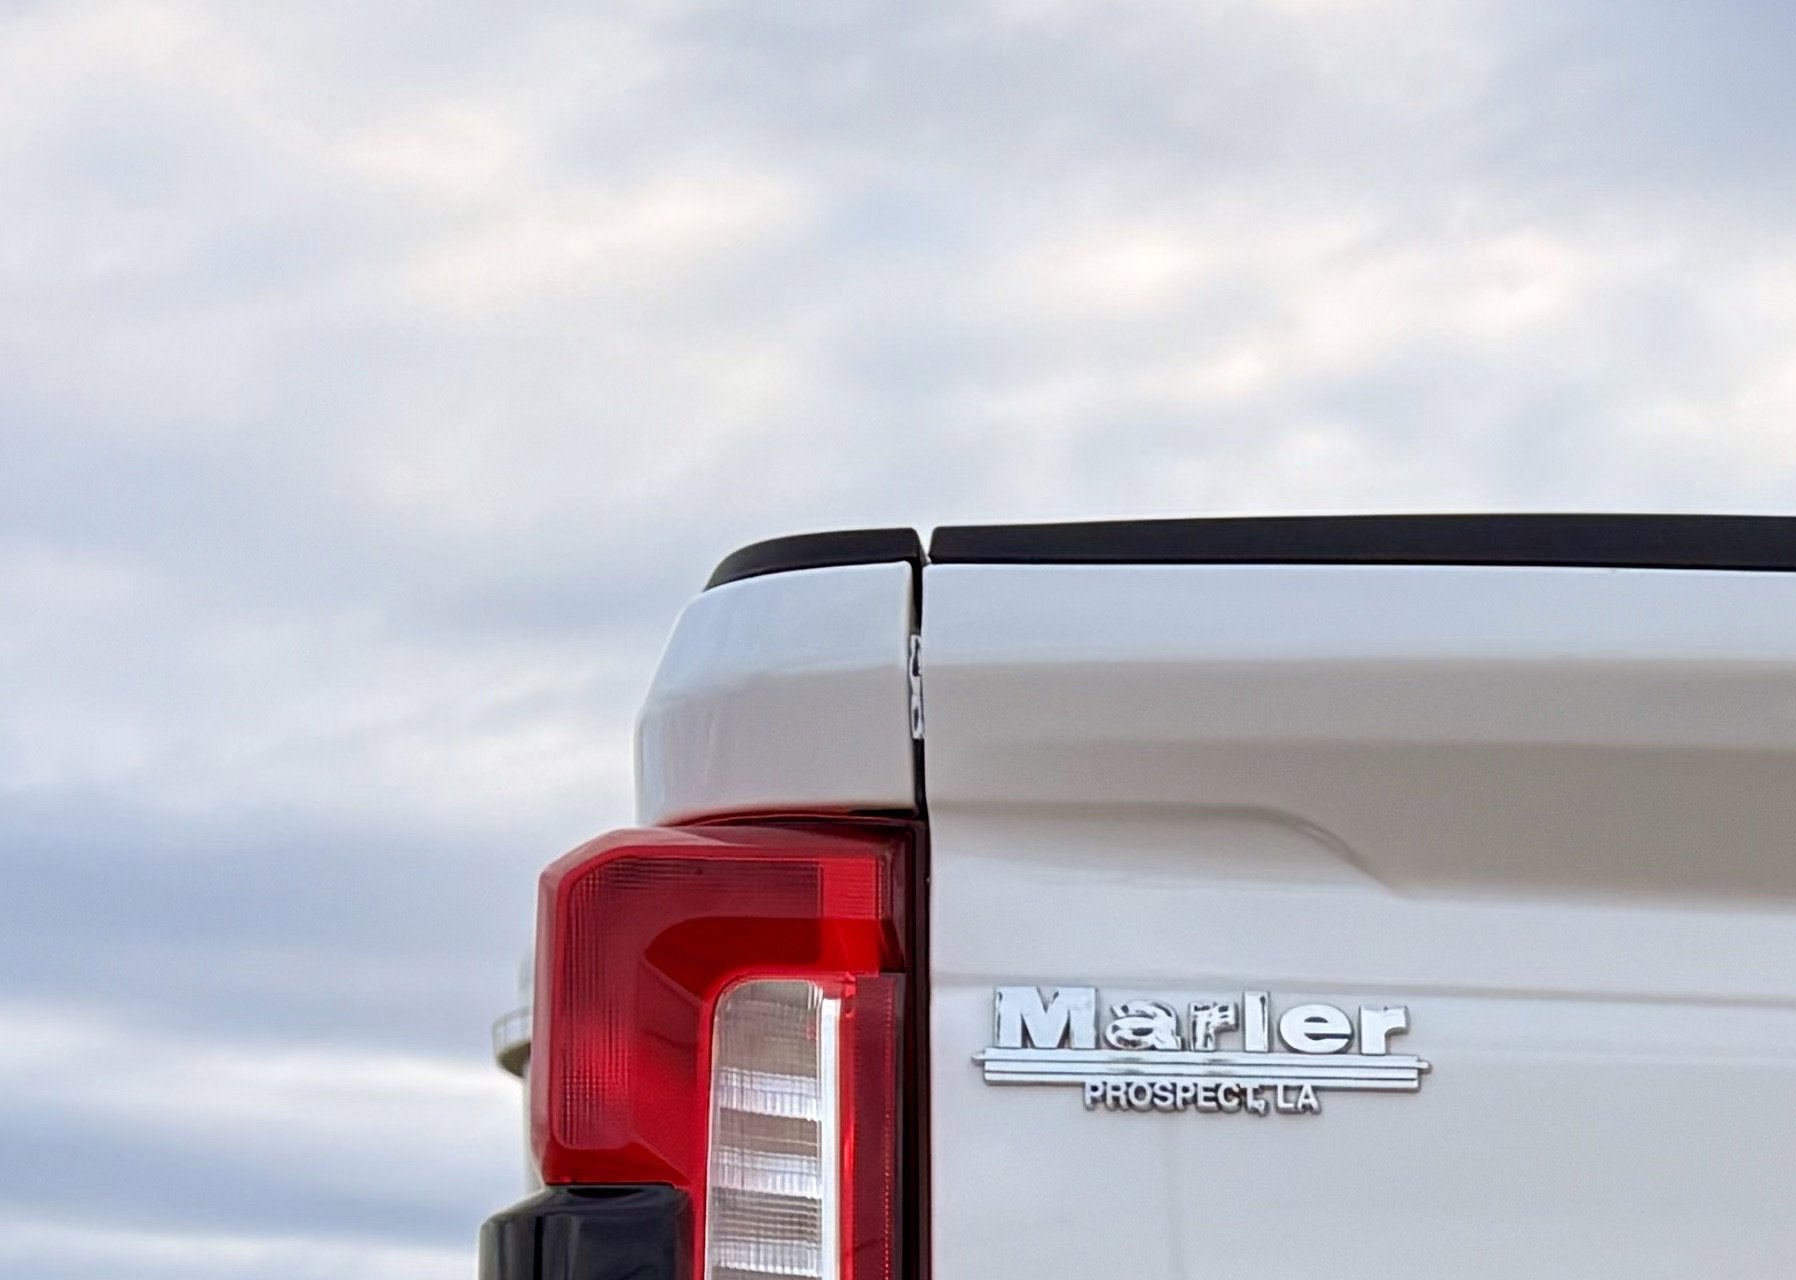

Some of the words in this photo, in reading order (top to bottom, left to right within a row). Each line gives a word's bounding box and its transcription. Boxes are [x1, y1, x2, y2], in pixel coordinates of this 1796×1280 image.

[995, 985, 1409, 1055] Marler
[1084, 1081, 1268, 1117] PROSPECT,
[1276, 1083, 1321, 1113] LA
